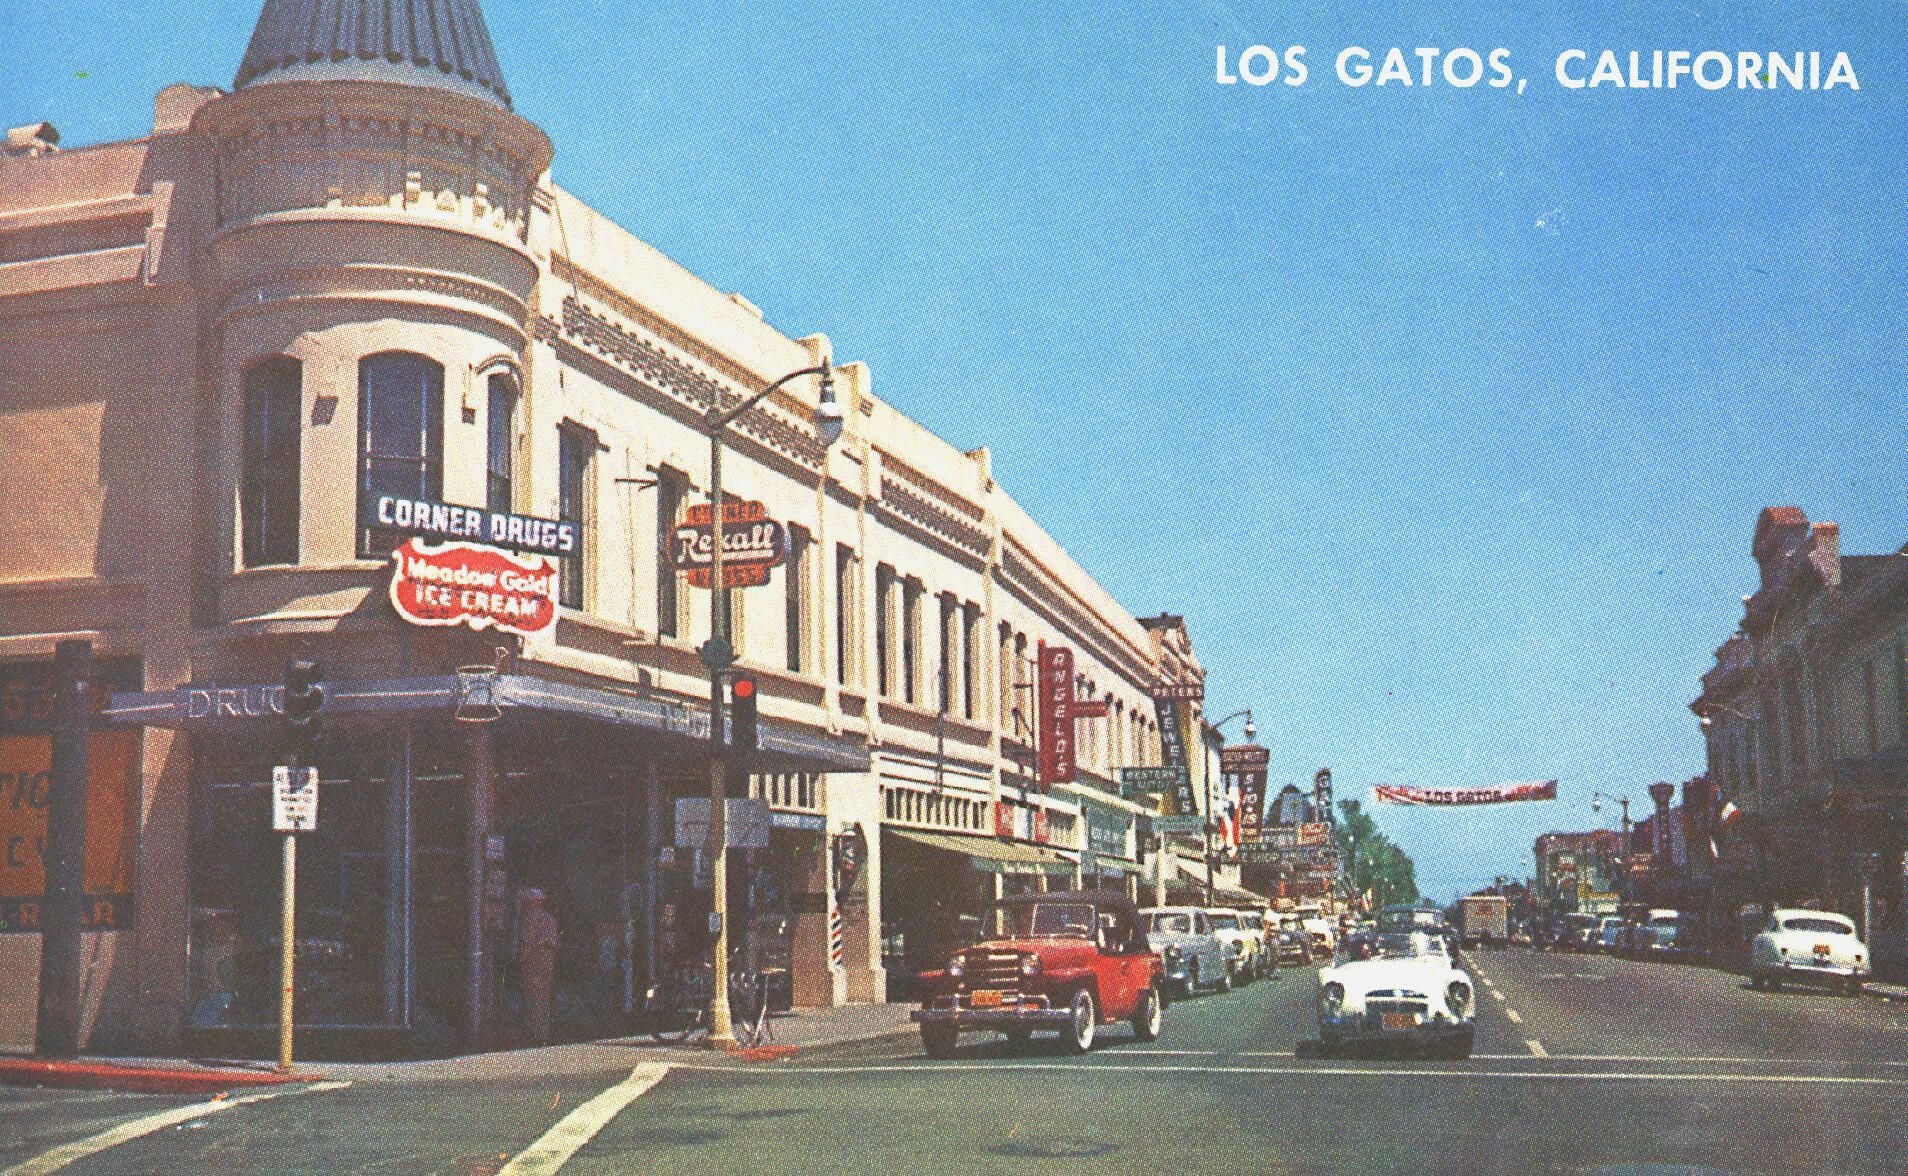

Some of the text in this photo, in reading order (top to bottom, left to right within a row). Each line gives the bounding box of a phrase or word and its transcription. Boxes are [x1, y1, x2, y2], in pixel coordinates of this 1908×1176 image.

[378, 496, 574, 551] CORNER DRUGS
[407, 556, 549, 596] Meadow Gold
[415, 584, 538, 617] ICE CREAM
[1153, 687, 1203, 698] PETERS
[1052, 652, 1068, 777] ANGELO'S
[1125, 770, 1177, 780] WESTERN
[1424, 789, 1502, 805] LOS GATOS
